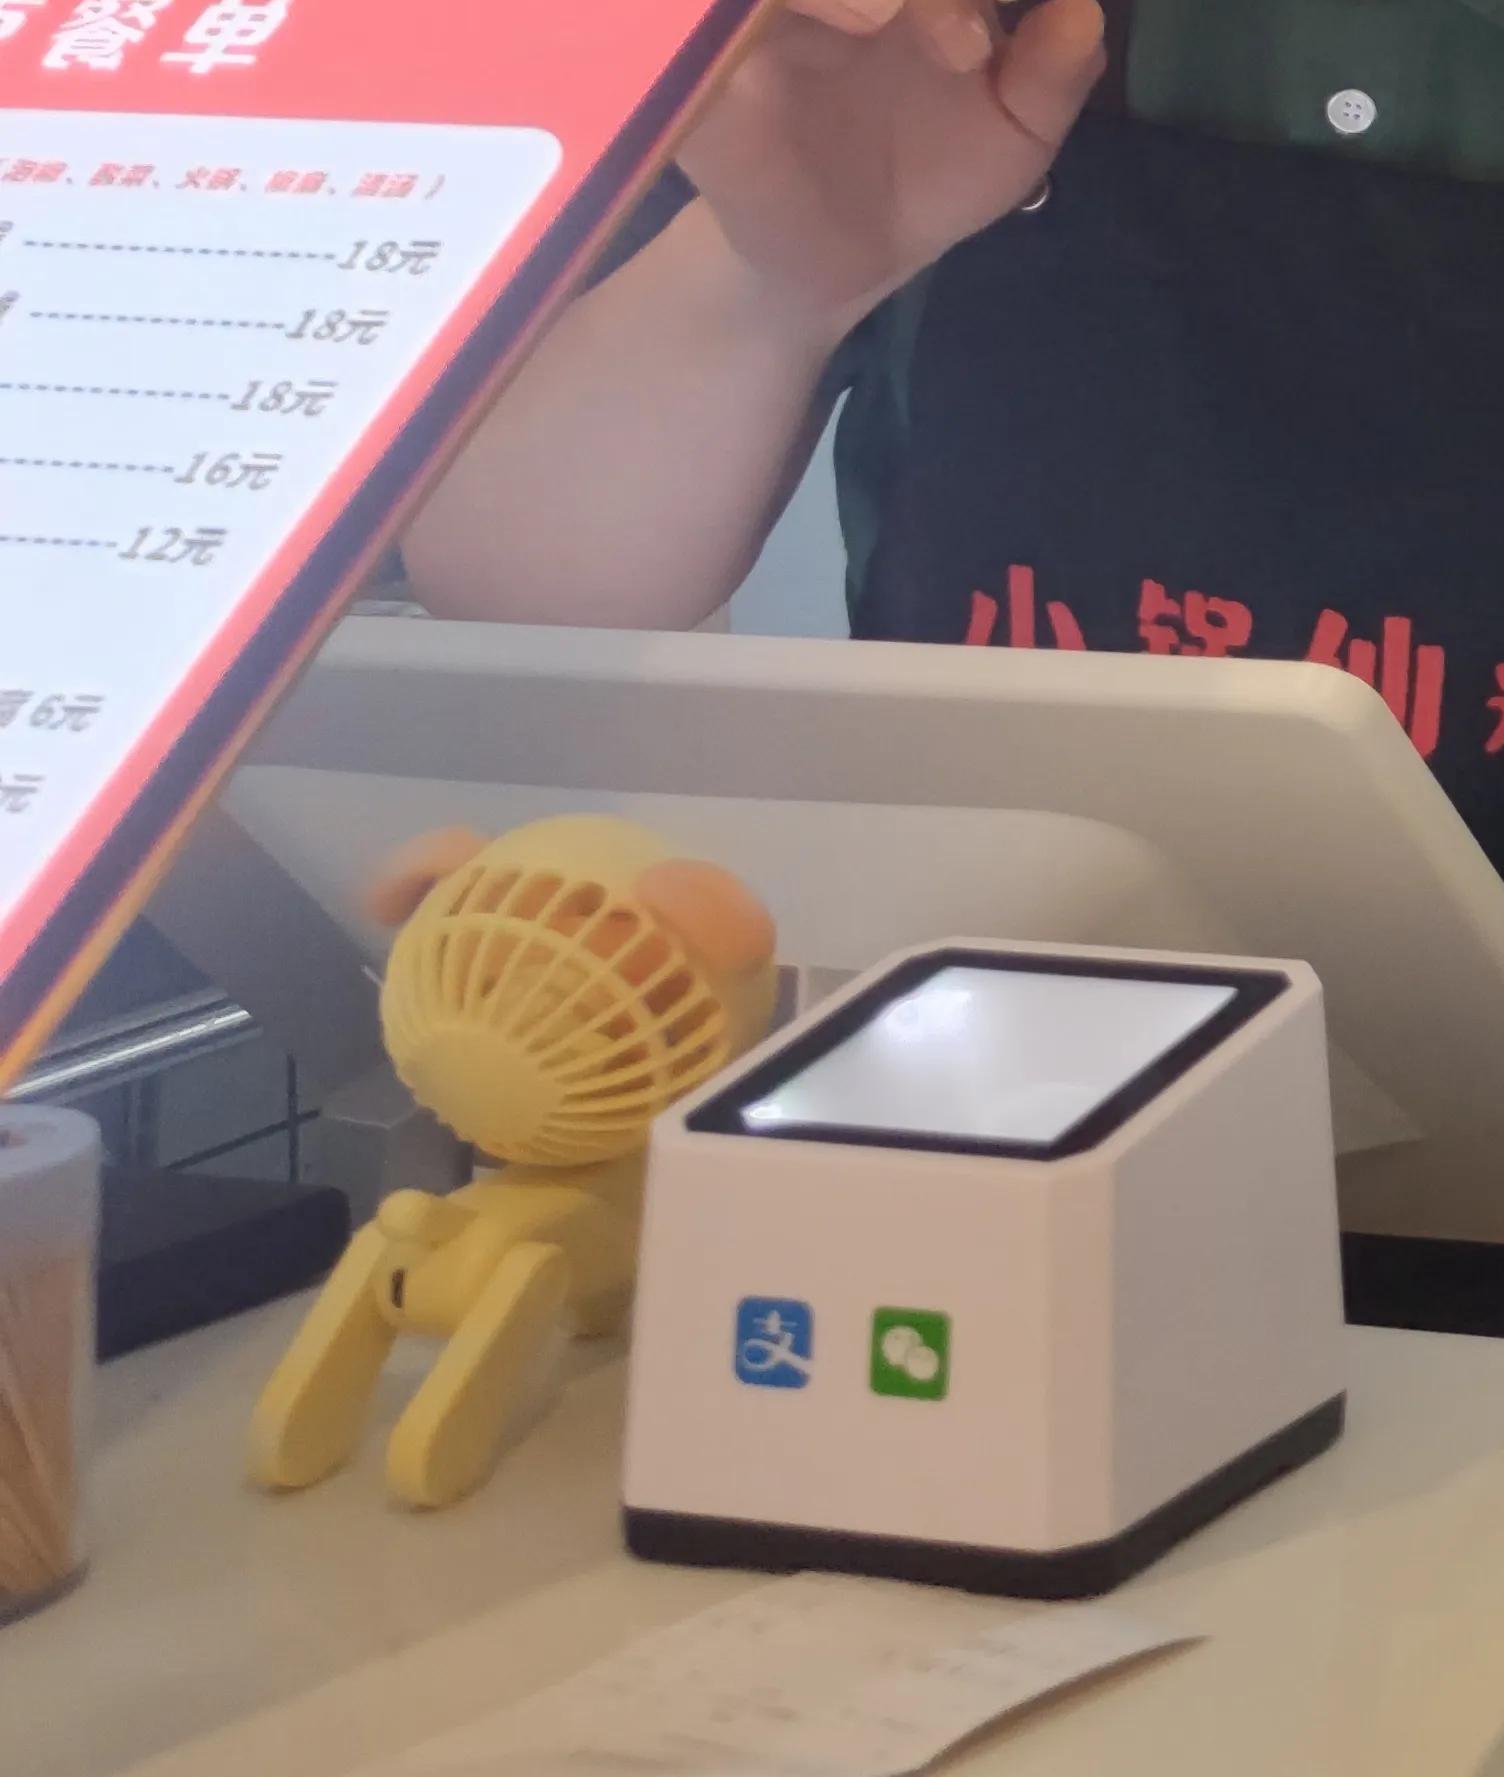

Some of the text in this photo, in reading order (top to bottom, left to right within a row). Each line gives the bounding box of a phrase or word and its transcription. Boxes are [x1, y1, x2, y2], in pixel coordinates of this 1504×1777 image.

[337, 239, 442, 275] 18元
[285, 309, 389, 345] 18元
[230, 380, 338, 417] 18元
[174, 452, 283, 490] 16元
[118, 526, 227, 565] 12元
